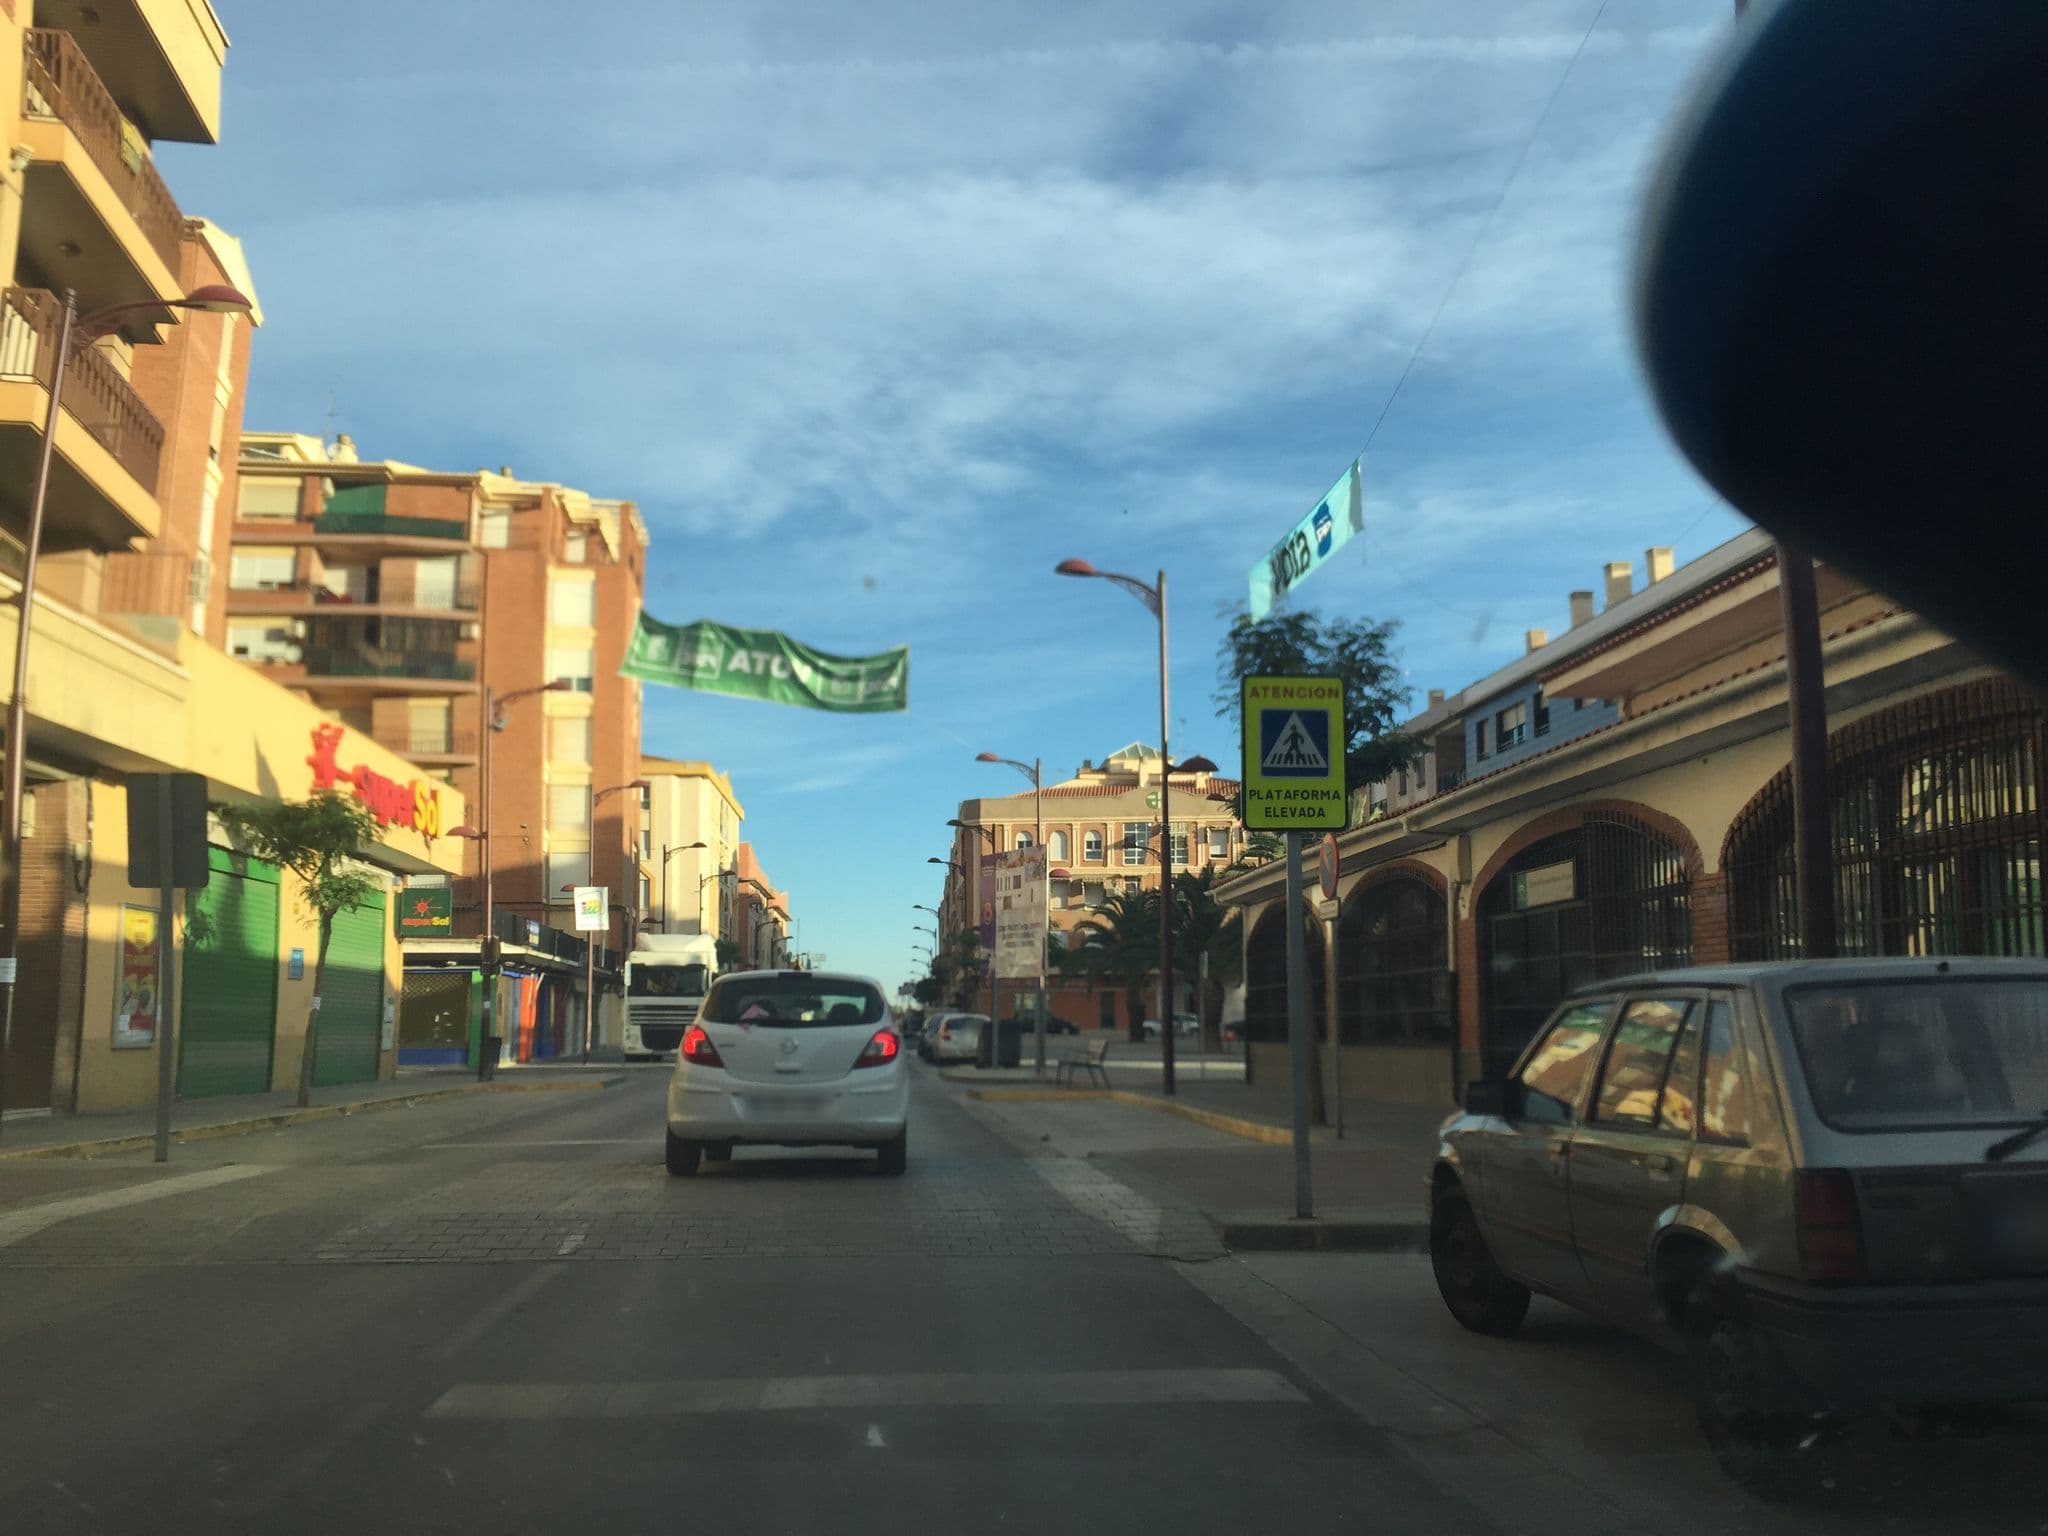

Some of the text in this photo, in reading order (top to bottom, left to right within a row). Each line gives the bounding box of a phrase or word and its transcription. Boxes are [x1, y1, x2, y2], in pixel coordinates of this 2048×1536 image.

[1249, 686, 1339, 699] ATENCION
[1249, 789, 1341, 801] PLATAFORMA
[1264, 807, 1326, 818] ELEVADA
